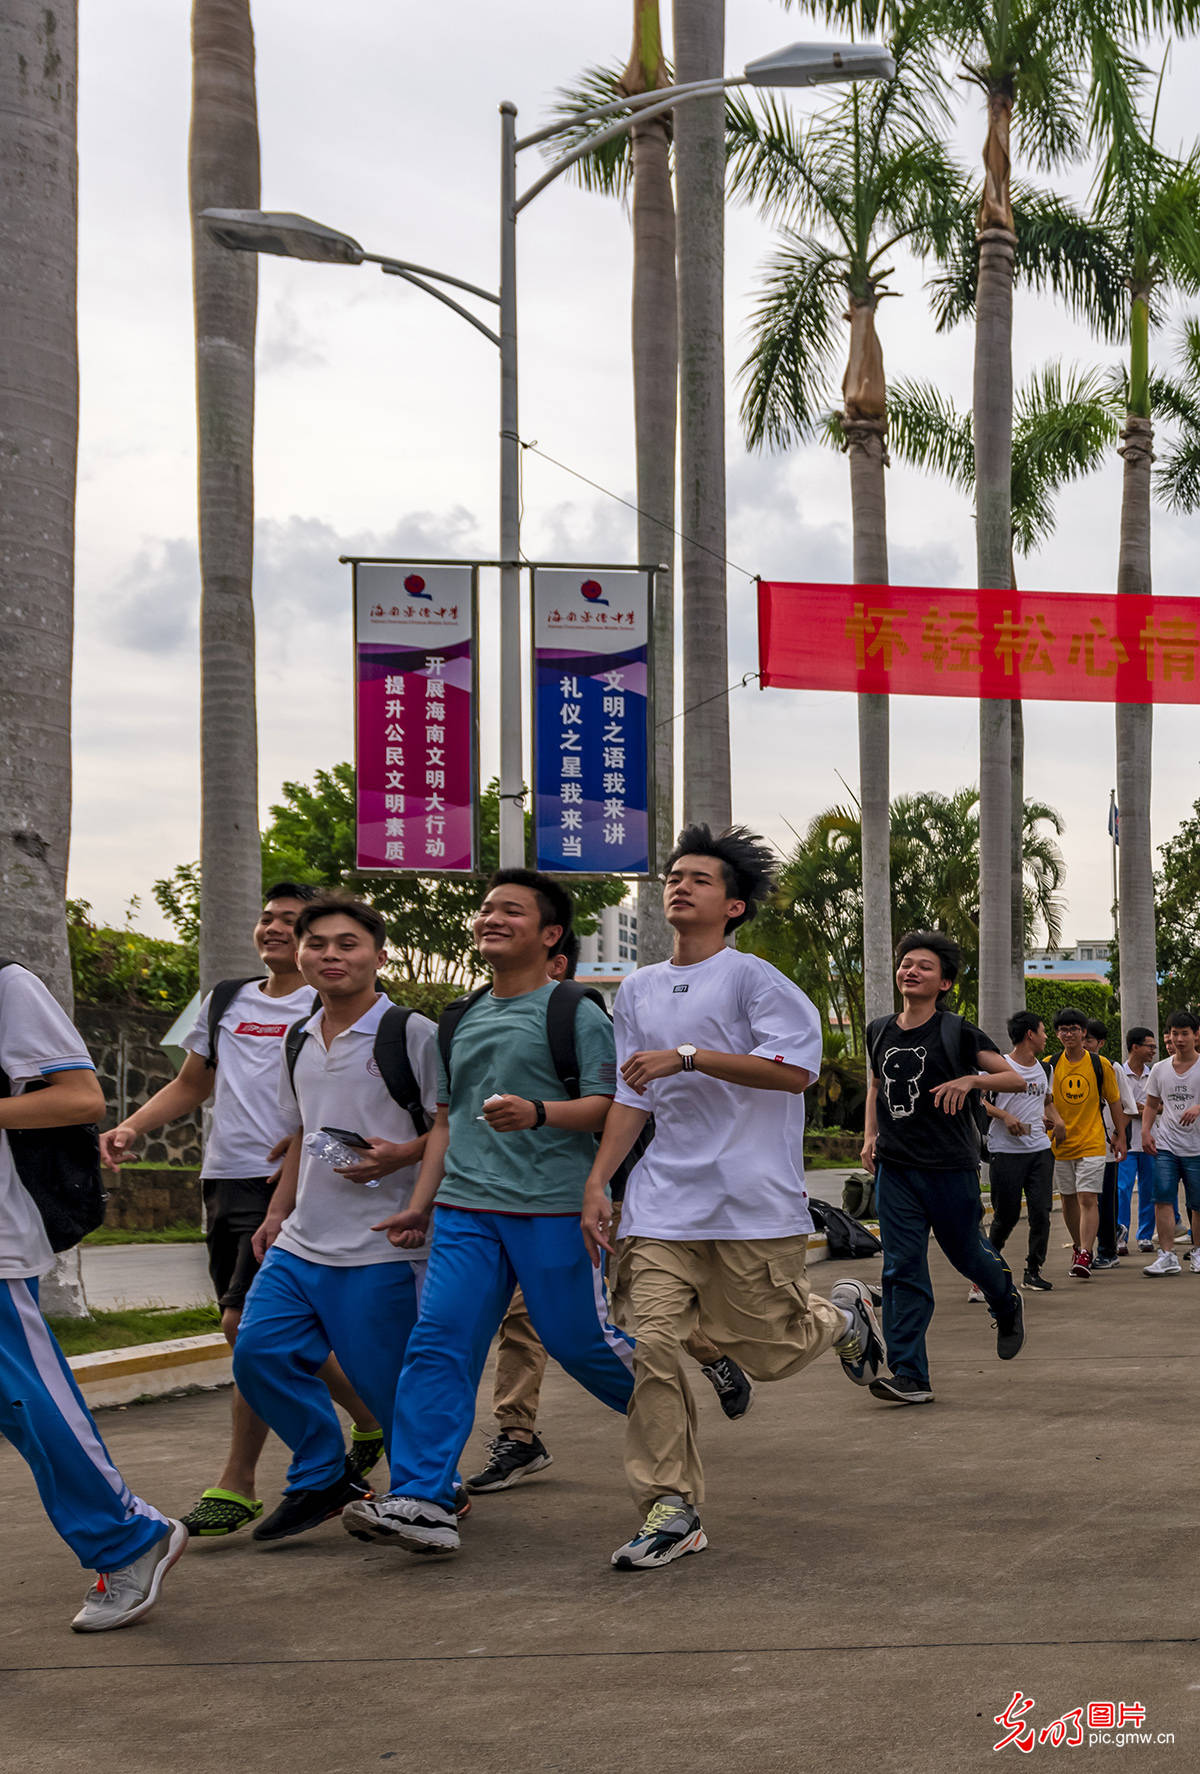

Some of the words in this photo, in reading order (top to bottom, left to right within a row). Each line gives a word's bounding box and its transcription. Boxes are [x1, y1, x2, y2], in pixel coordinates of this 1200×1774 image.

[844, 602, 1199, 682] 怀轻松心情
[385, 675, 405, 861] 提升公民文明素质
[425, 656, 446, 858] 开展海南文明大行动
[560, 676, 583, 857] 礼仪之星我来当
[603, 671, 626, 845] 文明之语我来讲
